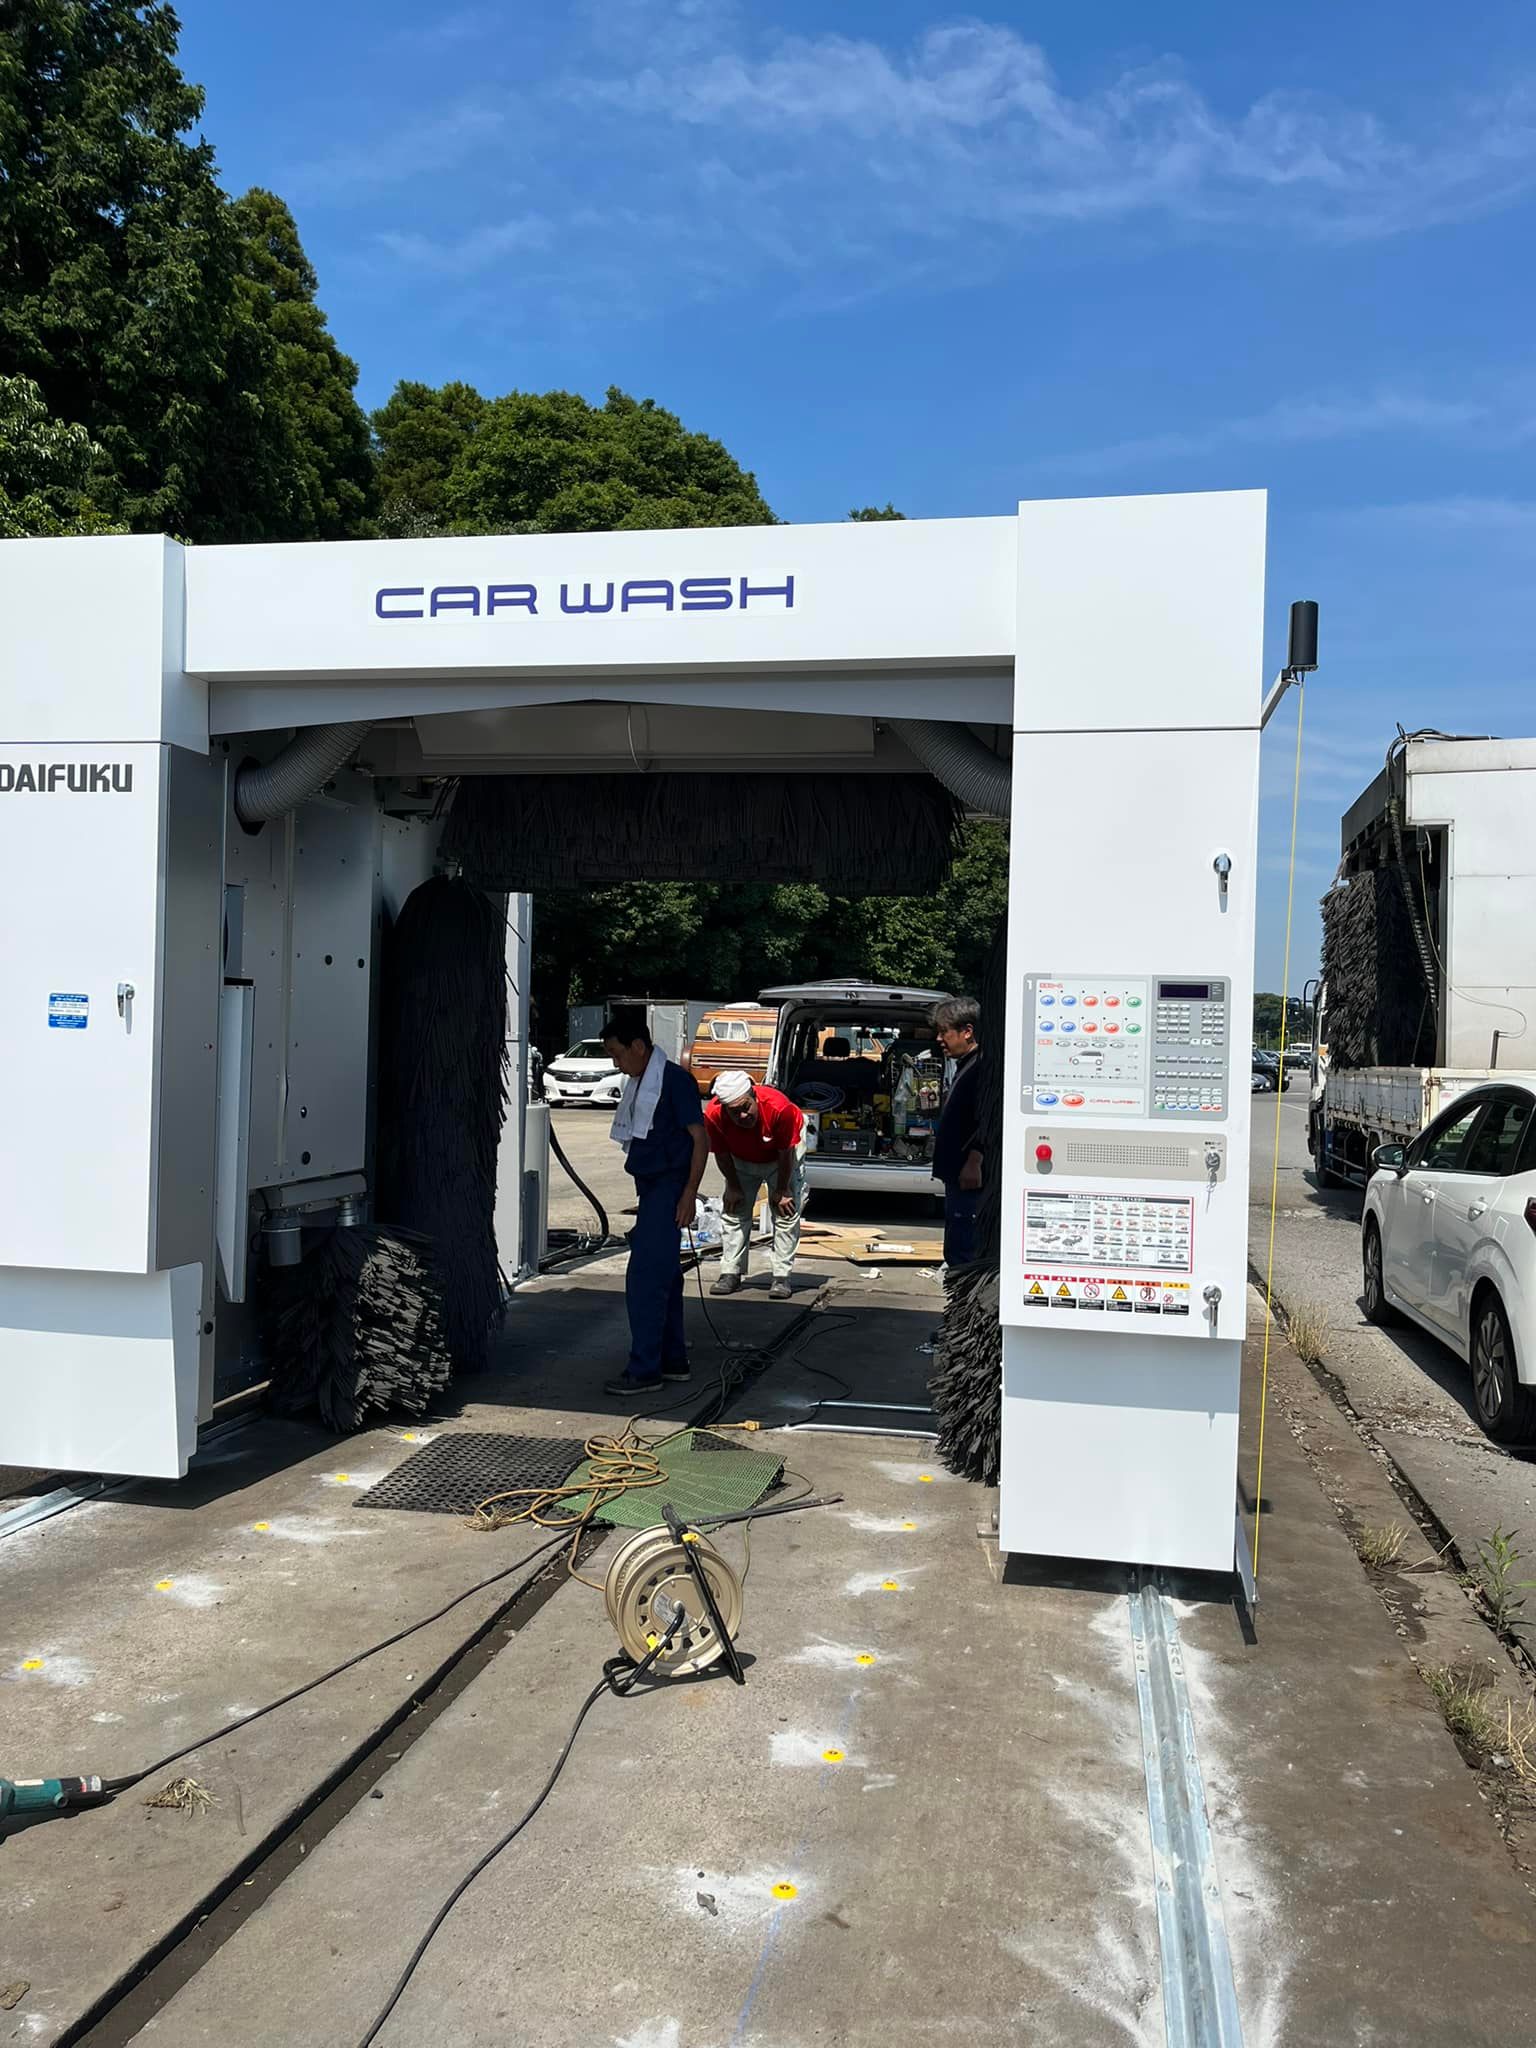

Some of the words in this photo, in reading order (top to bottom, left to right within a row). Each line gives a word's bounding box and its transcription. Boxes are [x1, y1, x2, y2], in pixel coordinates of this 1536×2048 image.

[375, 584, 538, 619] CAR
[560, 575, 794, 614] WASH
[0, 763, 133, 793] DAIFUKU
[1026, 979, 1032, 990] 1
[1022, 1084, 1032, 1096] 2
